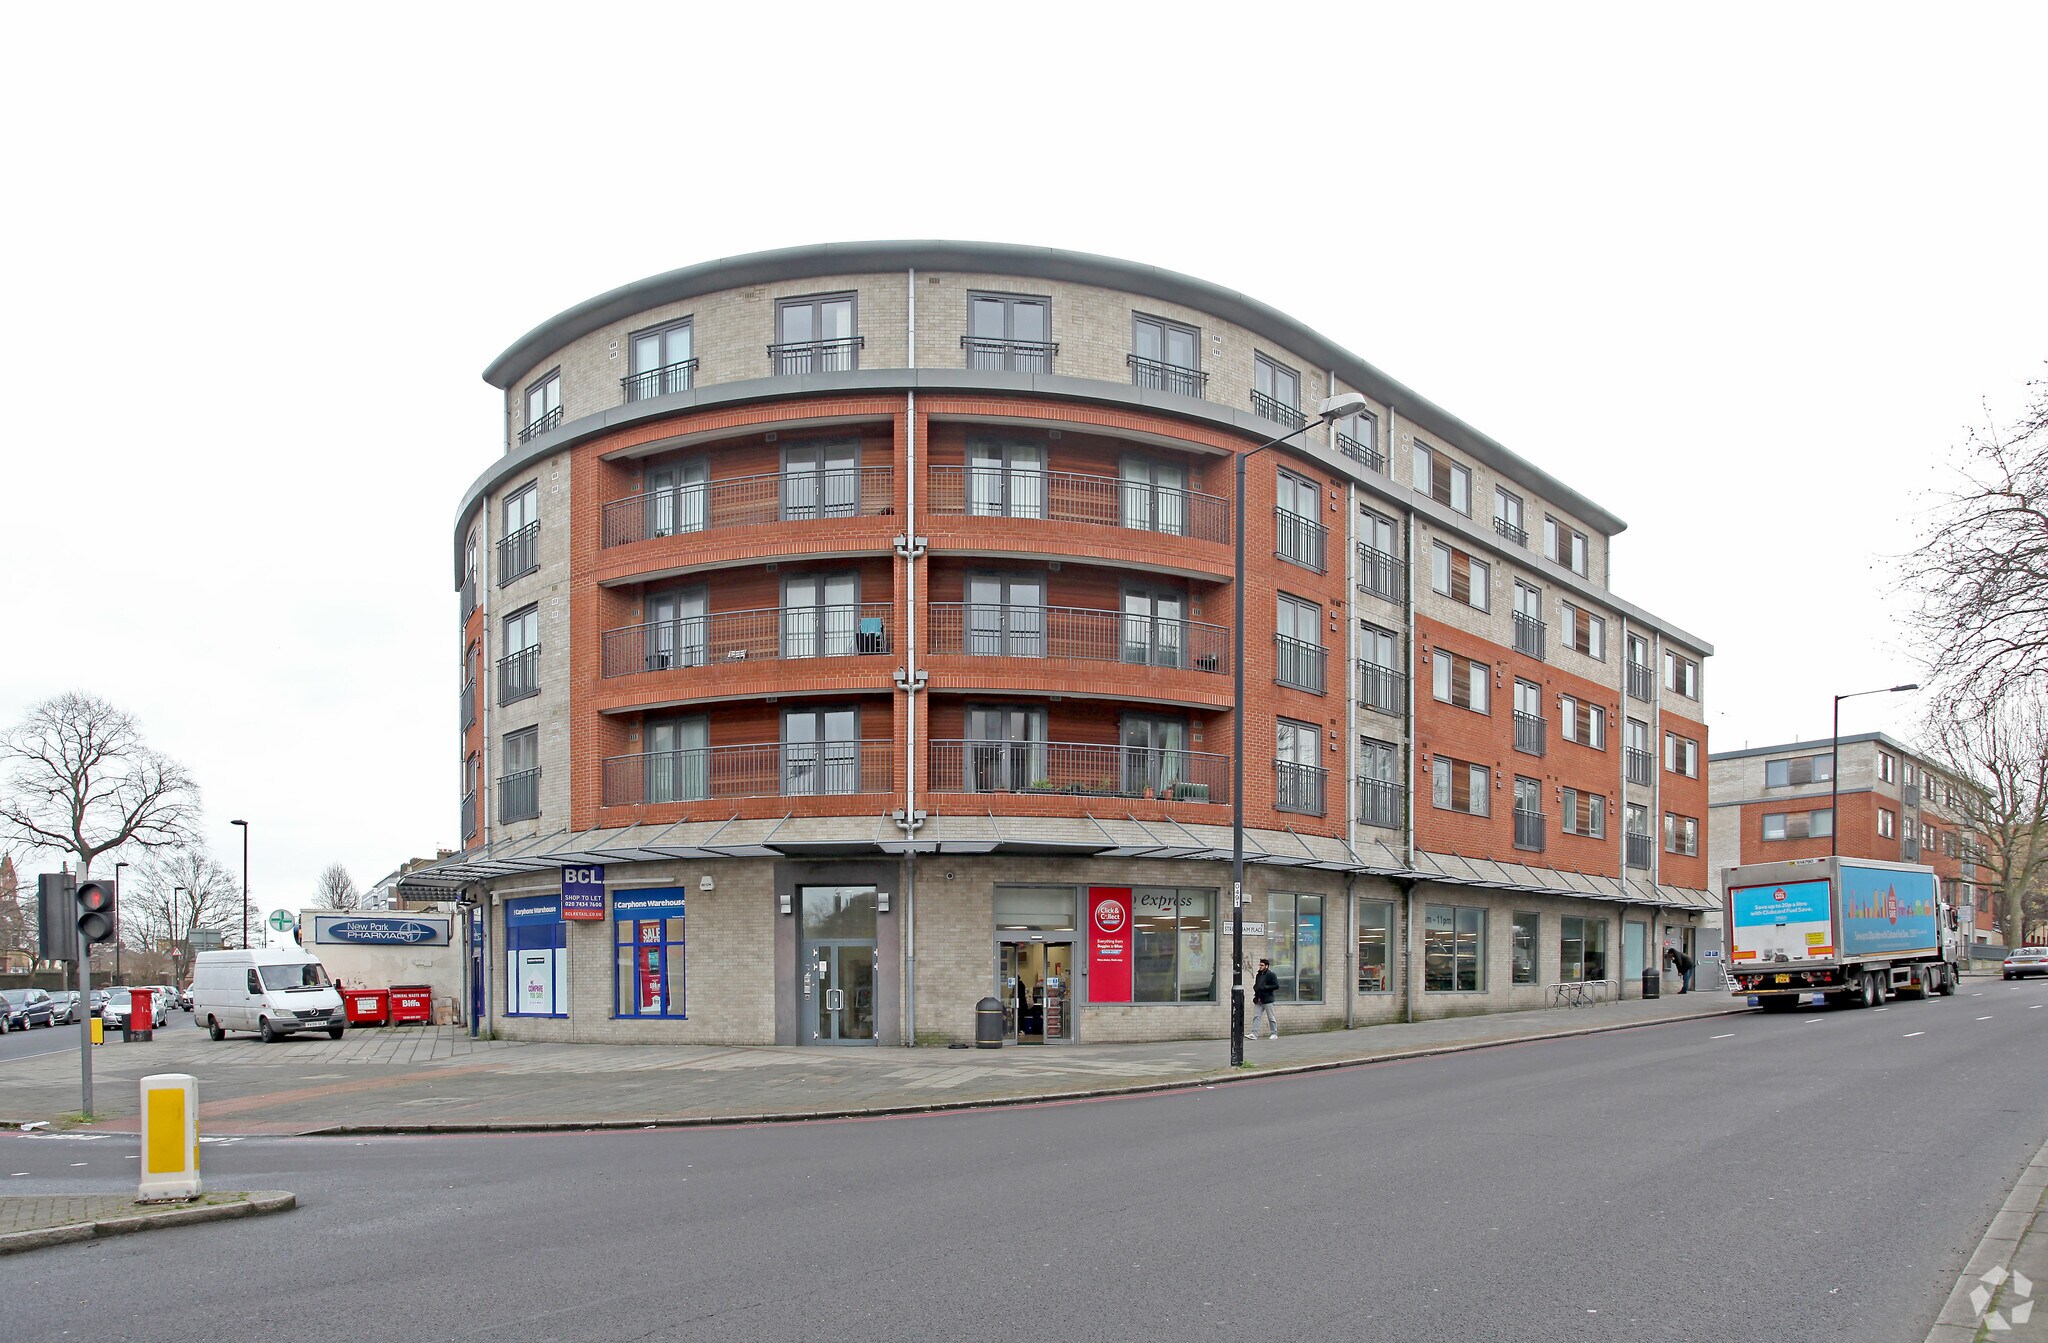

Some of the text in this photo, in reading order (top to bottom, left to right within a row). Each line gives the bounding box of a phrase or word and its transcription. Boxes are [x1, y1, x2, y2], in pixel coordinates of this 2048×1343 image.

[565, 869, 602, 884] BCL
[617, 900, 647, 909] Carphone
[647, 899, 686, 907] Warehouse
[1141, 893, 1193, 909] express
[515, 907, 534, 916] Carphone
[533, 906, 557, 914] Warehouse
[1436, 915, 1452, 927] 11pm
[347, 922, 389, 931] New Park
[347, 931, 412, 940] PHARMACY
[642, 927, 660, 940] SALE
[402, 999, 421, 1007] Biffa
